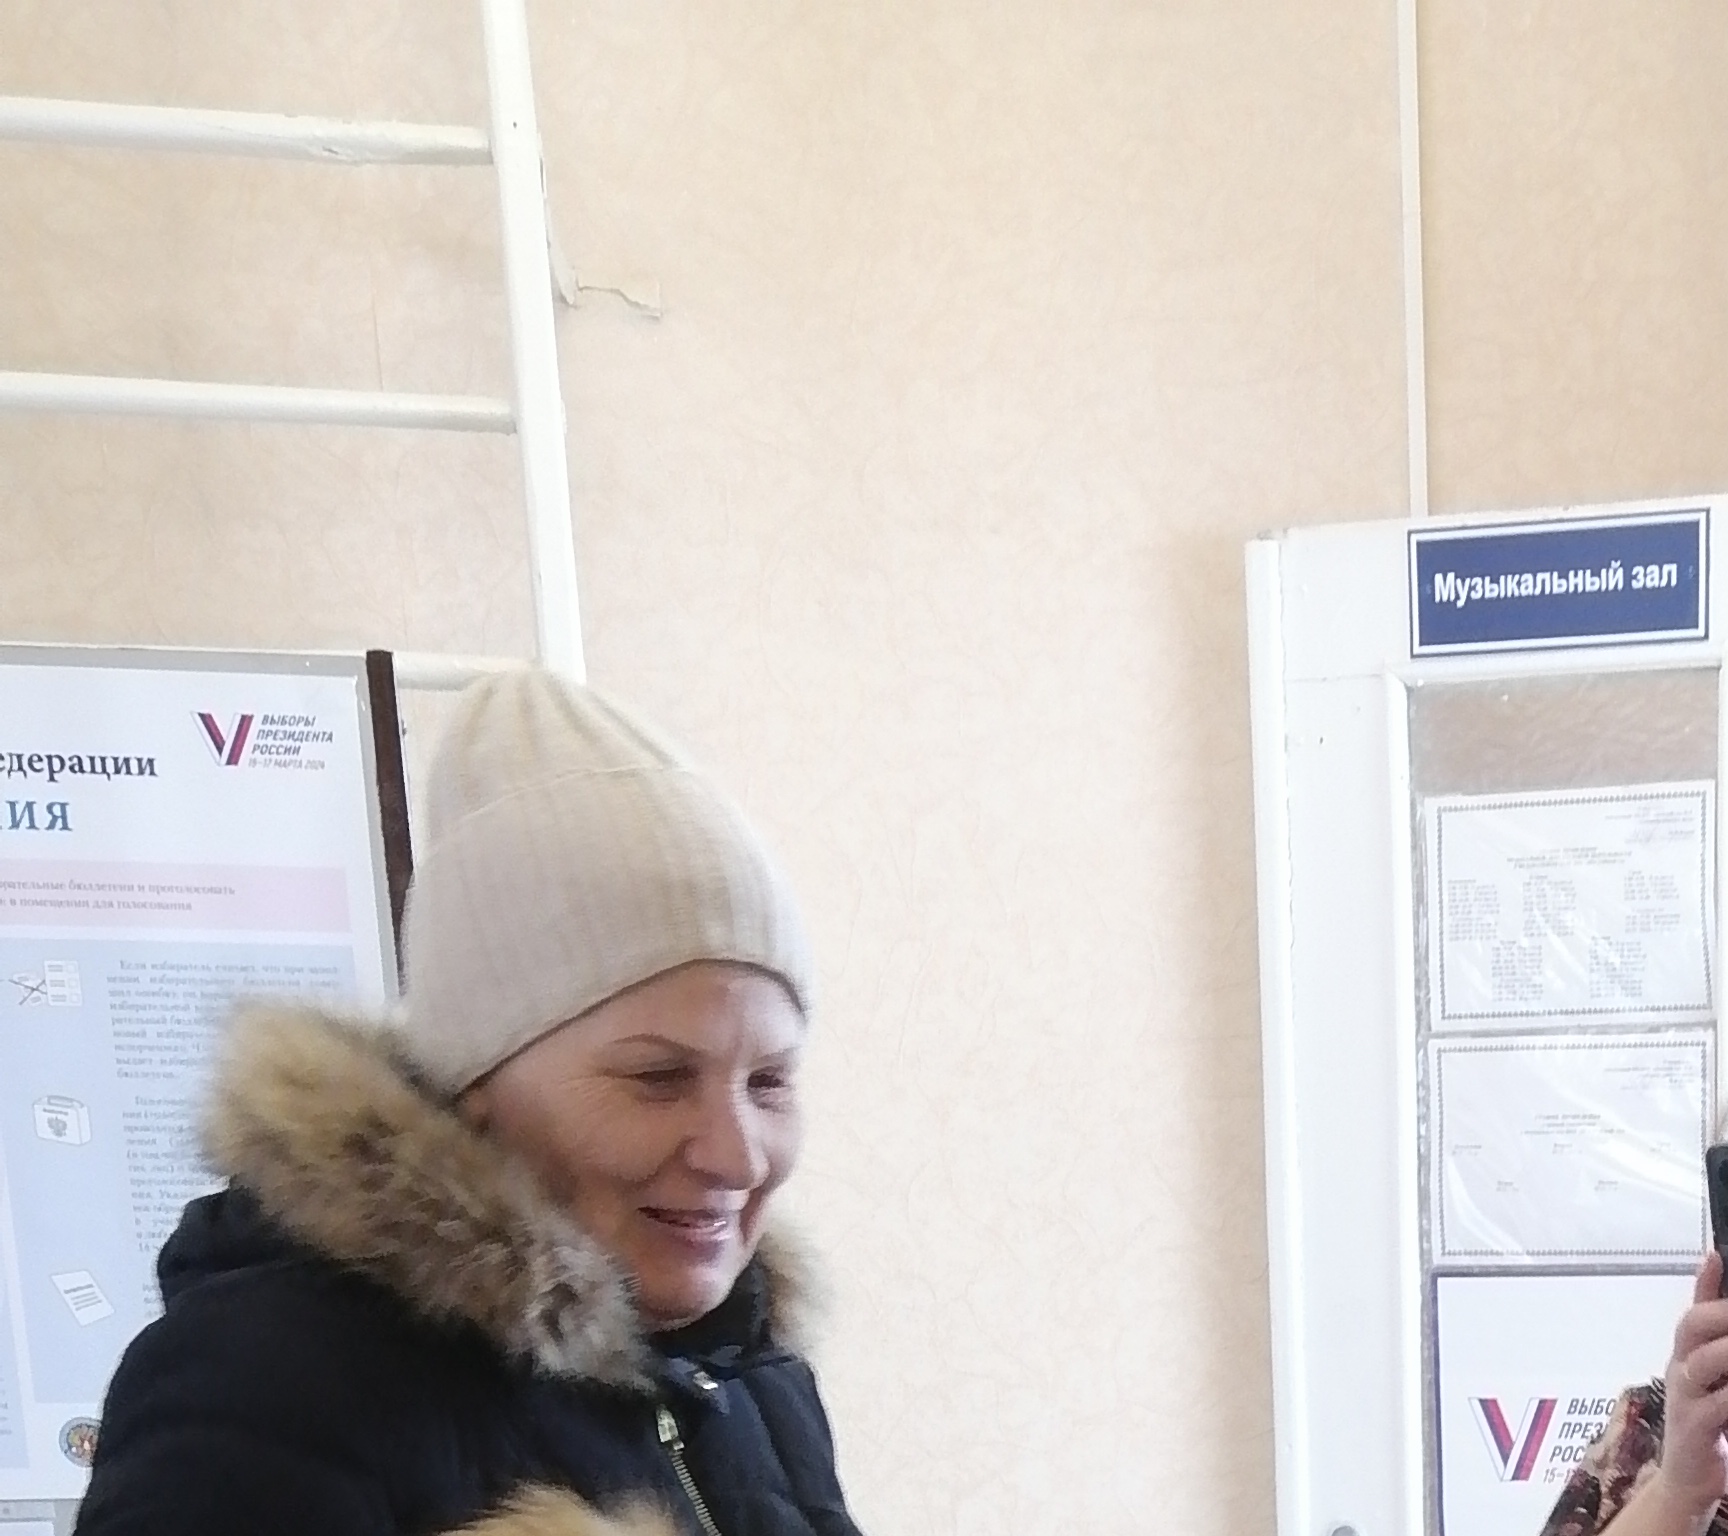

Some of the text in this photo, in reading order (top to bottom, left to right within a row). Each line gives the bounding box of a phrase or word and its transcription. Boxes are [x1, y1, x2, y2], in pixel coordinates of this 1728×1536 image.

[1433, 560, 1678, 608] Музыкальный зал
[261, 714, 316, 727] ВЫБОРЫ
[256, 729, 334, 744] ПРЕЗИДЕНТА
[251, 743, 301, 756] РОССИИ
[0, 800, 73, 832] ИЯ
[1566, 1397, 1617, 1416] ВЫБО
[1558, 1421, 1608, 1440] ПРЕЗ
[1549, 1445, 1586, 1463] РОС
